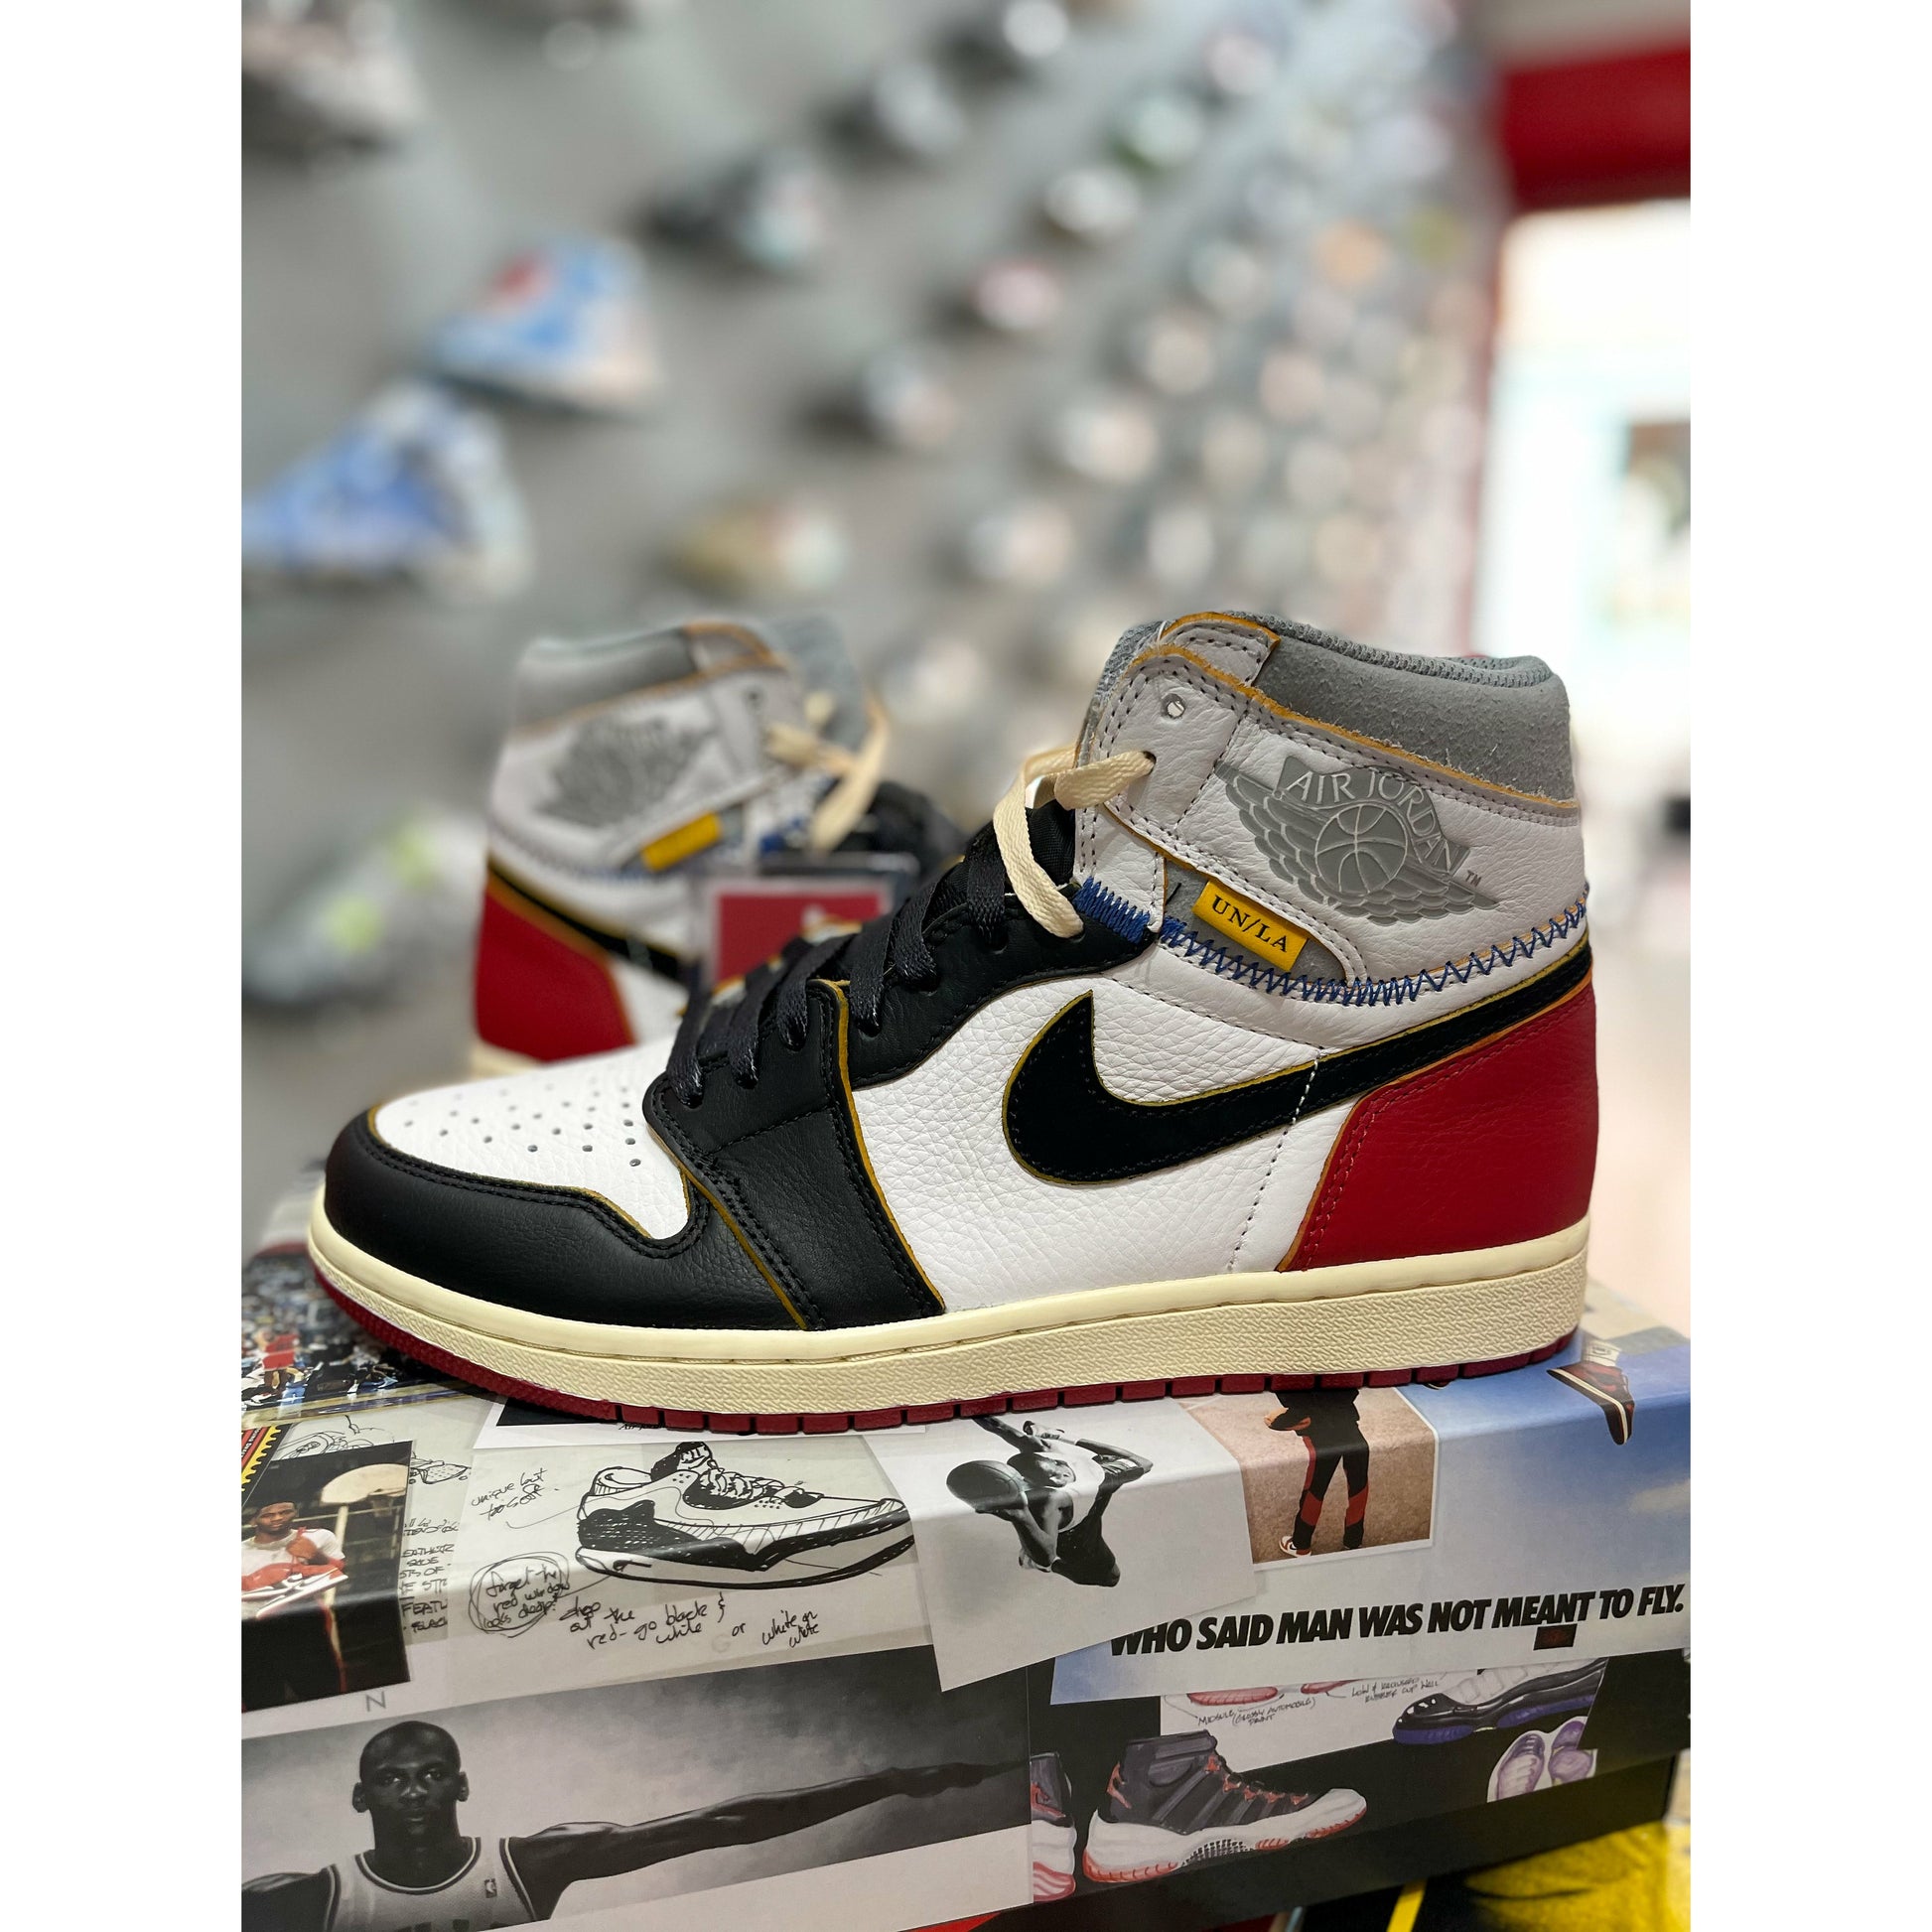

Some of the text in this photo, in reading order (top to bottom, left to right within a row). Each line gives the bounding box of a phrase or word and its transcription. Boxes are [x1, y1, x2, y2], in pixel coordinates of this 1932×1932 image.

[1286, 770, 1463, 875] AIR JORDAN
[1464, 869, 1482, 888] TM
[1211, 895, 1288, 953] UN/LA
[633, 1620, 658, 1641] go
[664, 1599, 708, 1626] black
[655, 1620, 703, 1645] white
[731, 1622, 747, 1637] or
[1110, 1583, 1686, 1656] WHO SAID MAN WAS NOT MEANT TO FLY.
[365, 1691, 386, 1712] N
